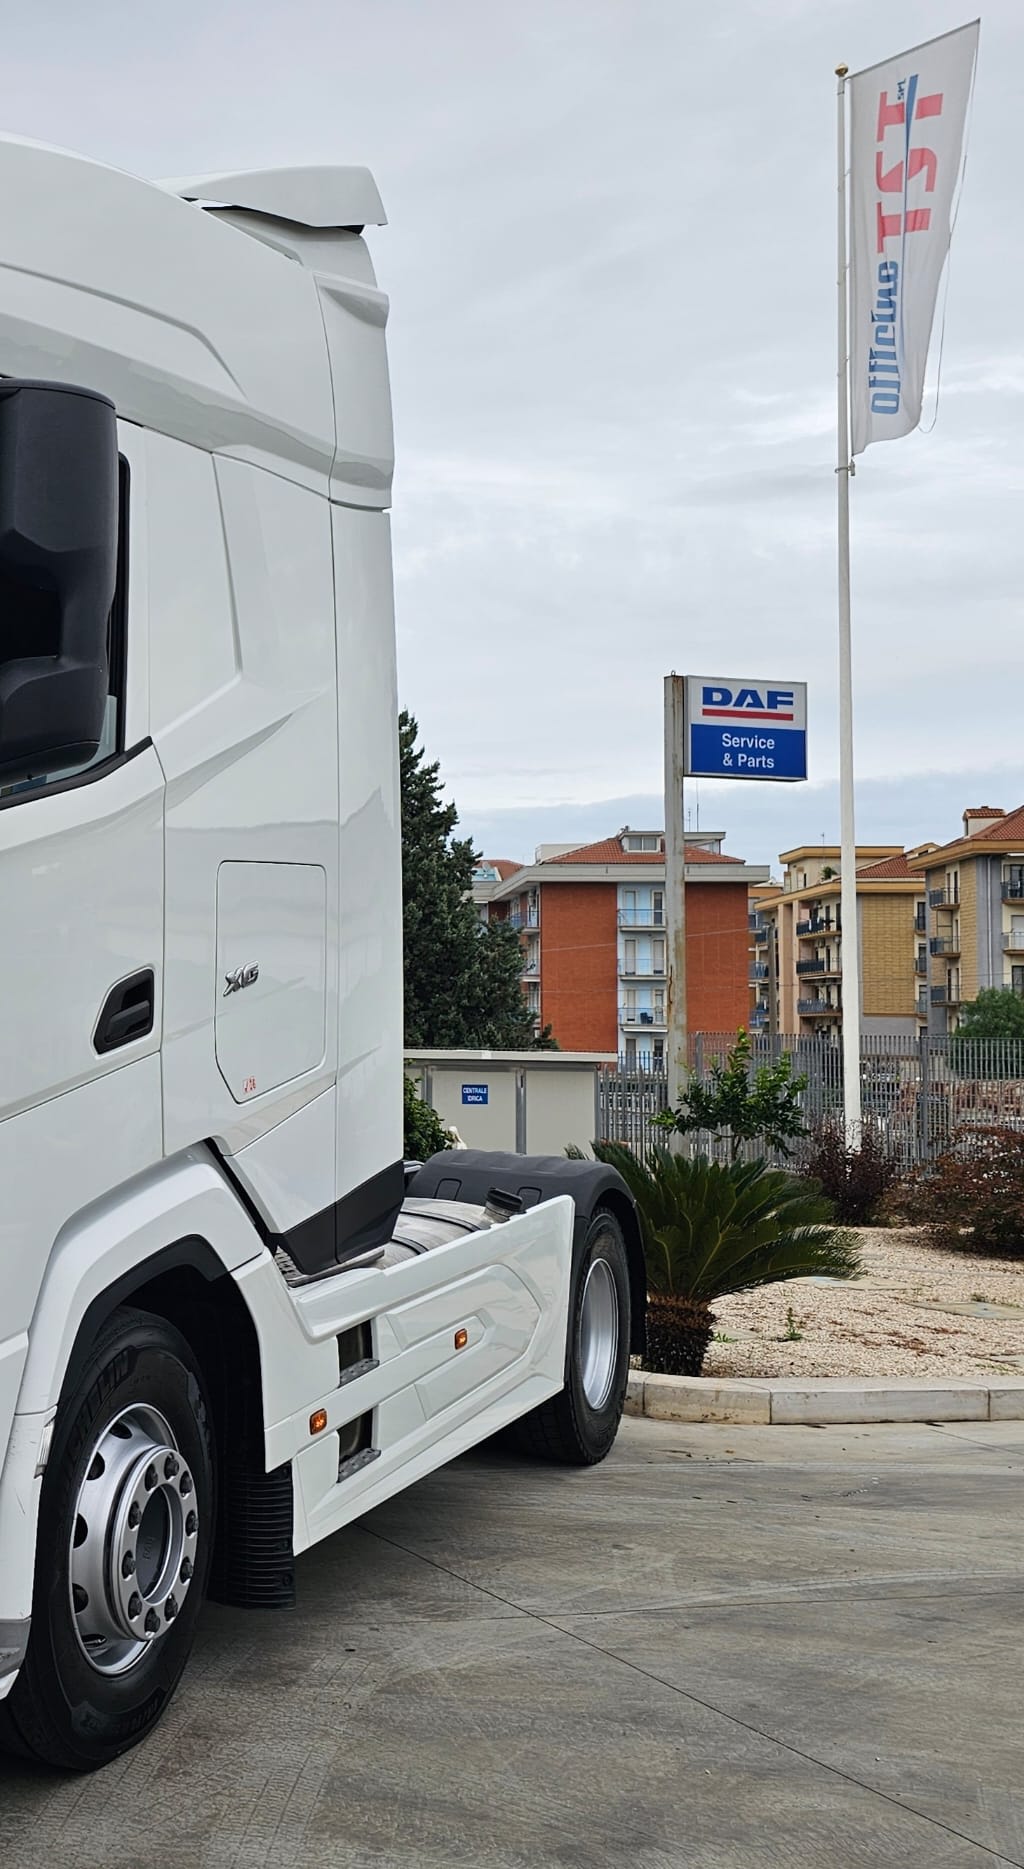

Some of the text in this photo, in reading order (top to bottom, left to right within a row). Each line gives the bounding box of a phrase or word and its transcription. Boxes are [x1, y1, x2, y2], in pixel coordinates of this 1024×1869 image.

[702, 686, 794, 710] DAF
[721, 732, 775, 749] Service
[722, 752, 775, 769] & Parts
